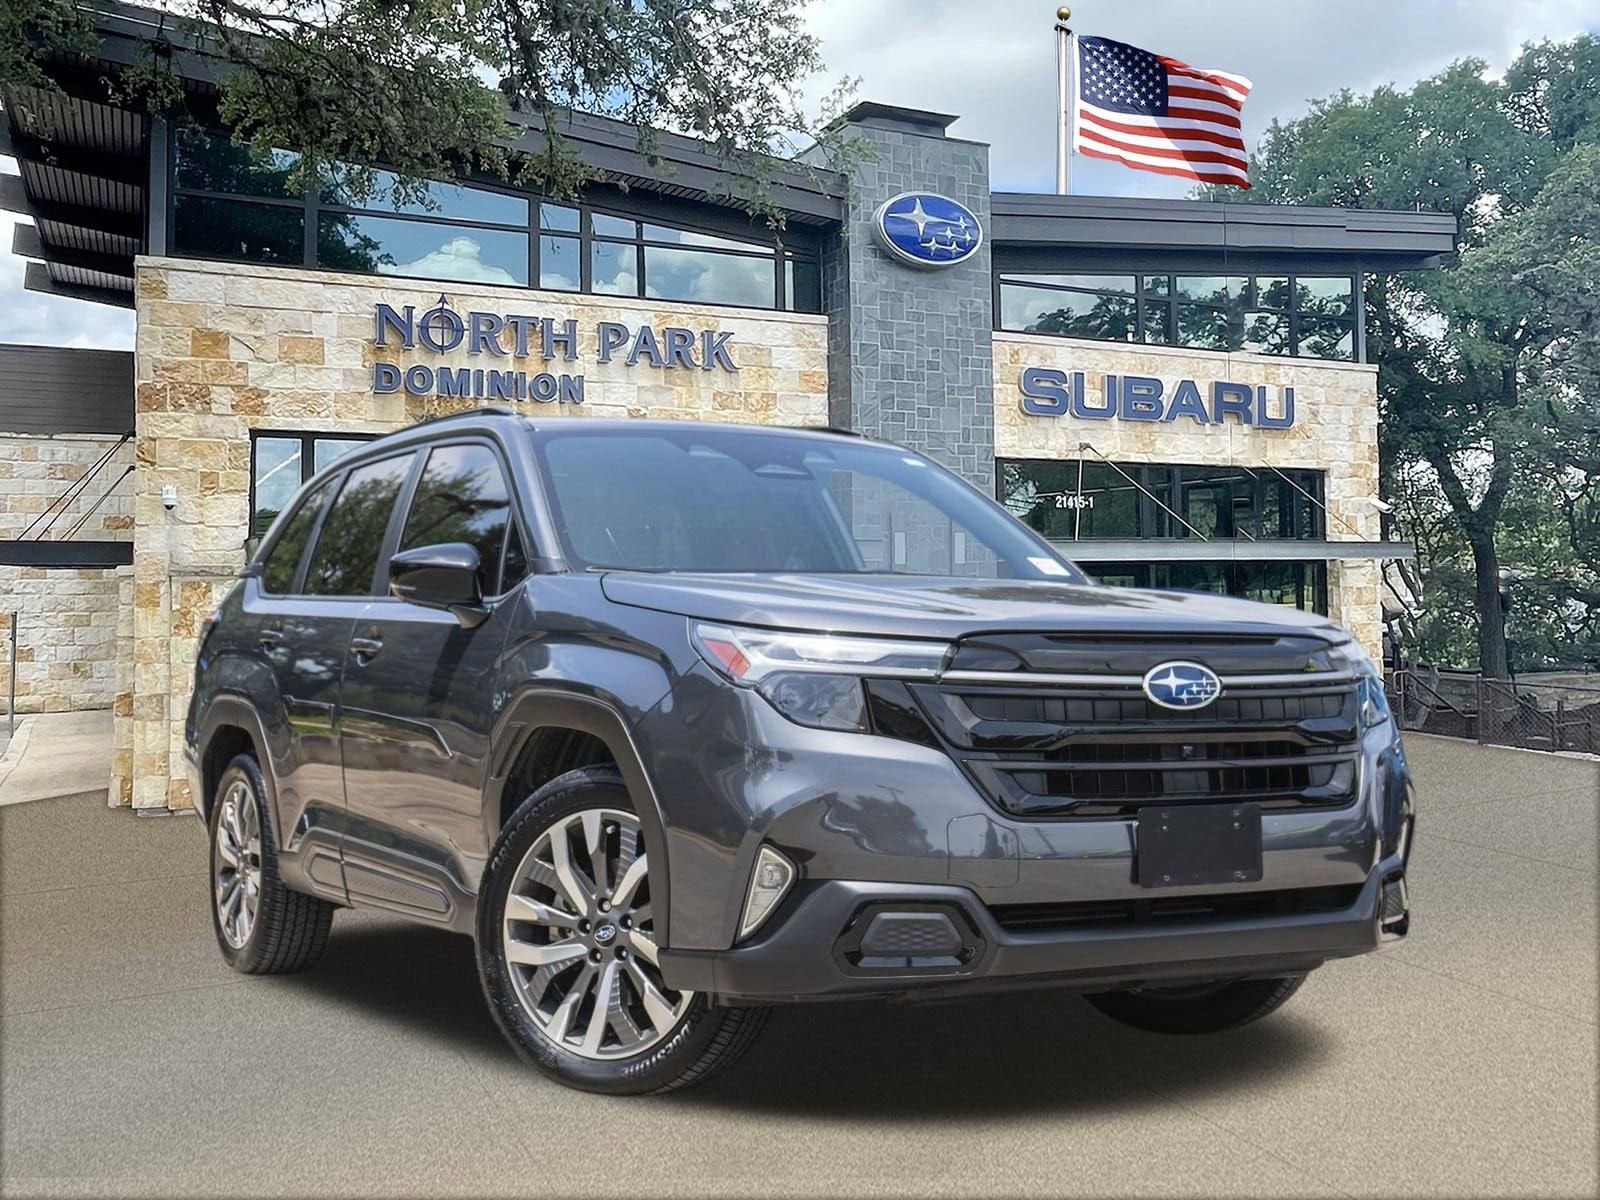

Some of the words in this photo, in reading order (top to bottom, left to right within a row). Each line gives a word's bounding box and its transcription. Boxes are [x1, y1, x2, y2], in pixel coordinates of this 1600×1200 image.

[375, 300, 579, 362] NORTH
[596, 321, 743, 374] PARK
[373, 362, 586, 405] DOMINION
[1019, 366, 1295, 431] SUBARU
[1055, 495, 1095, 509] 21415-1
